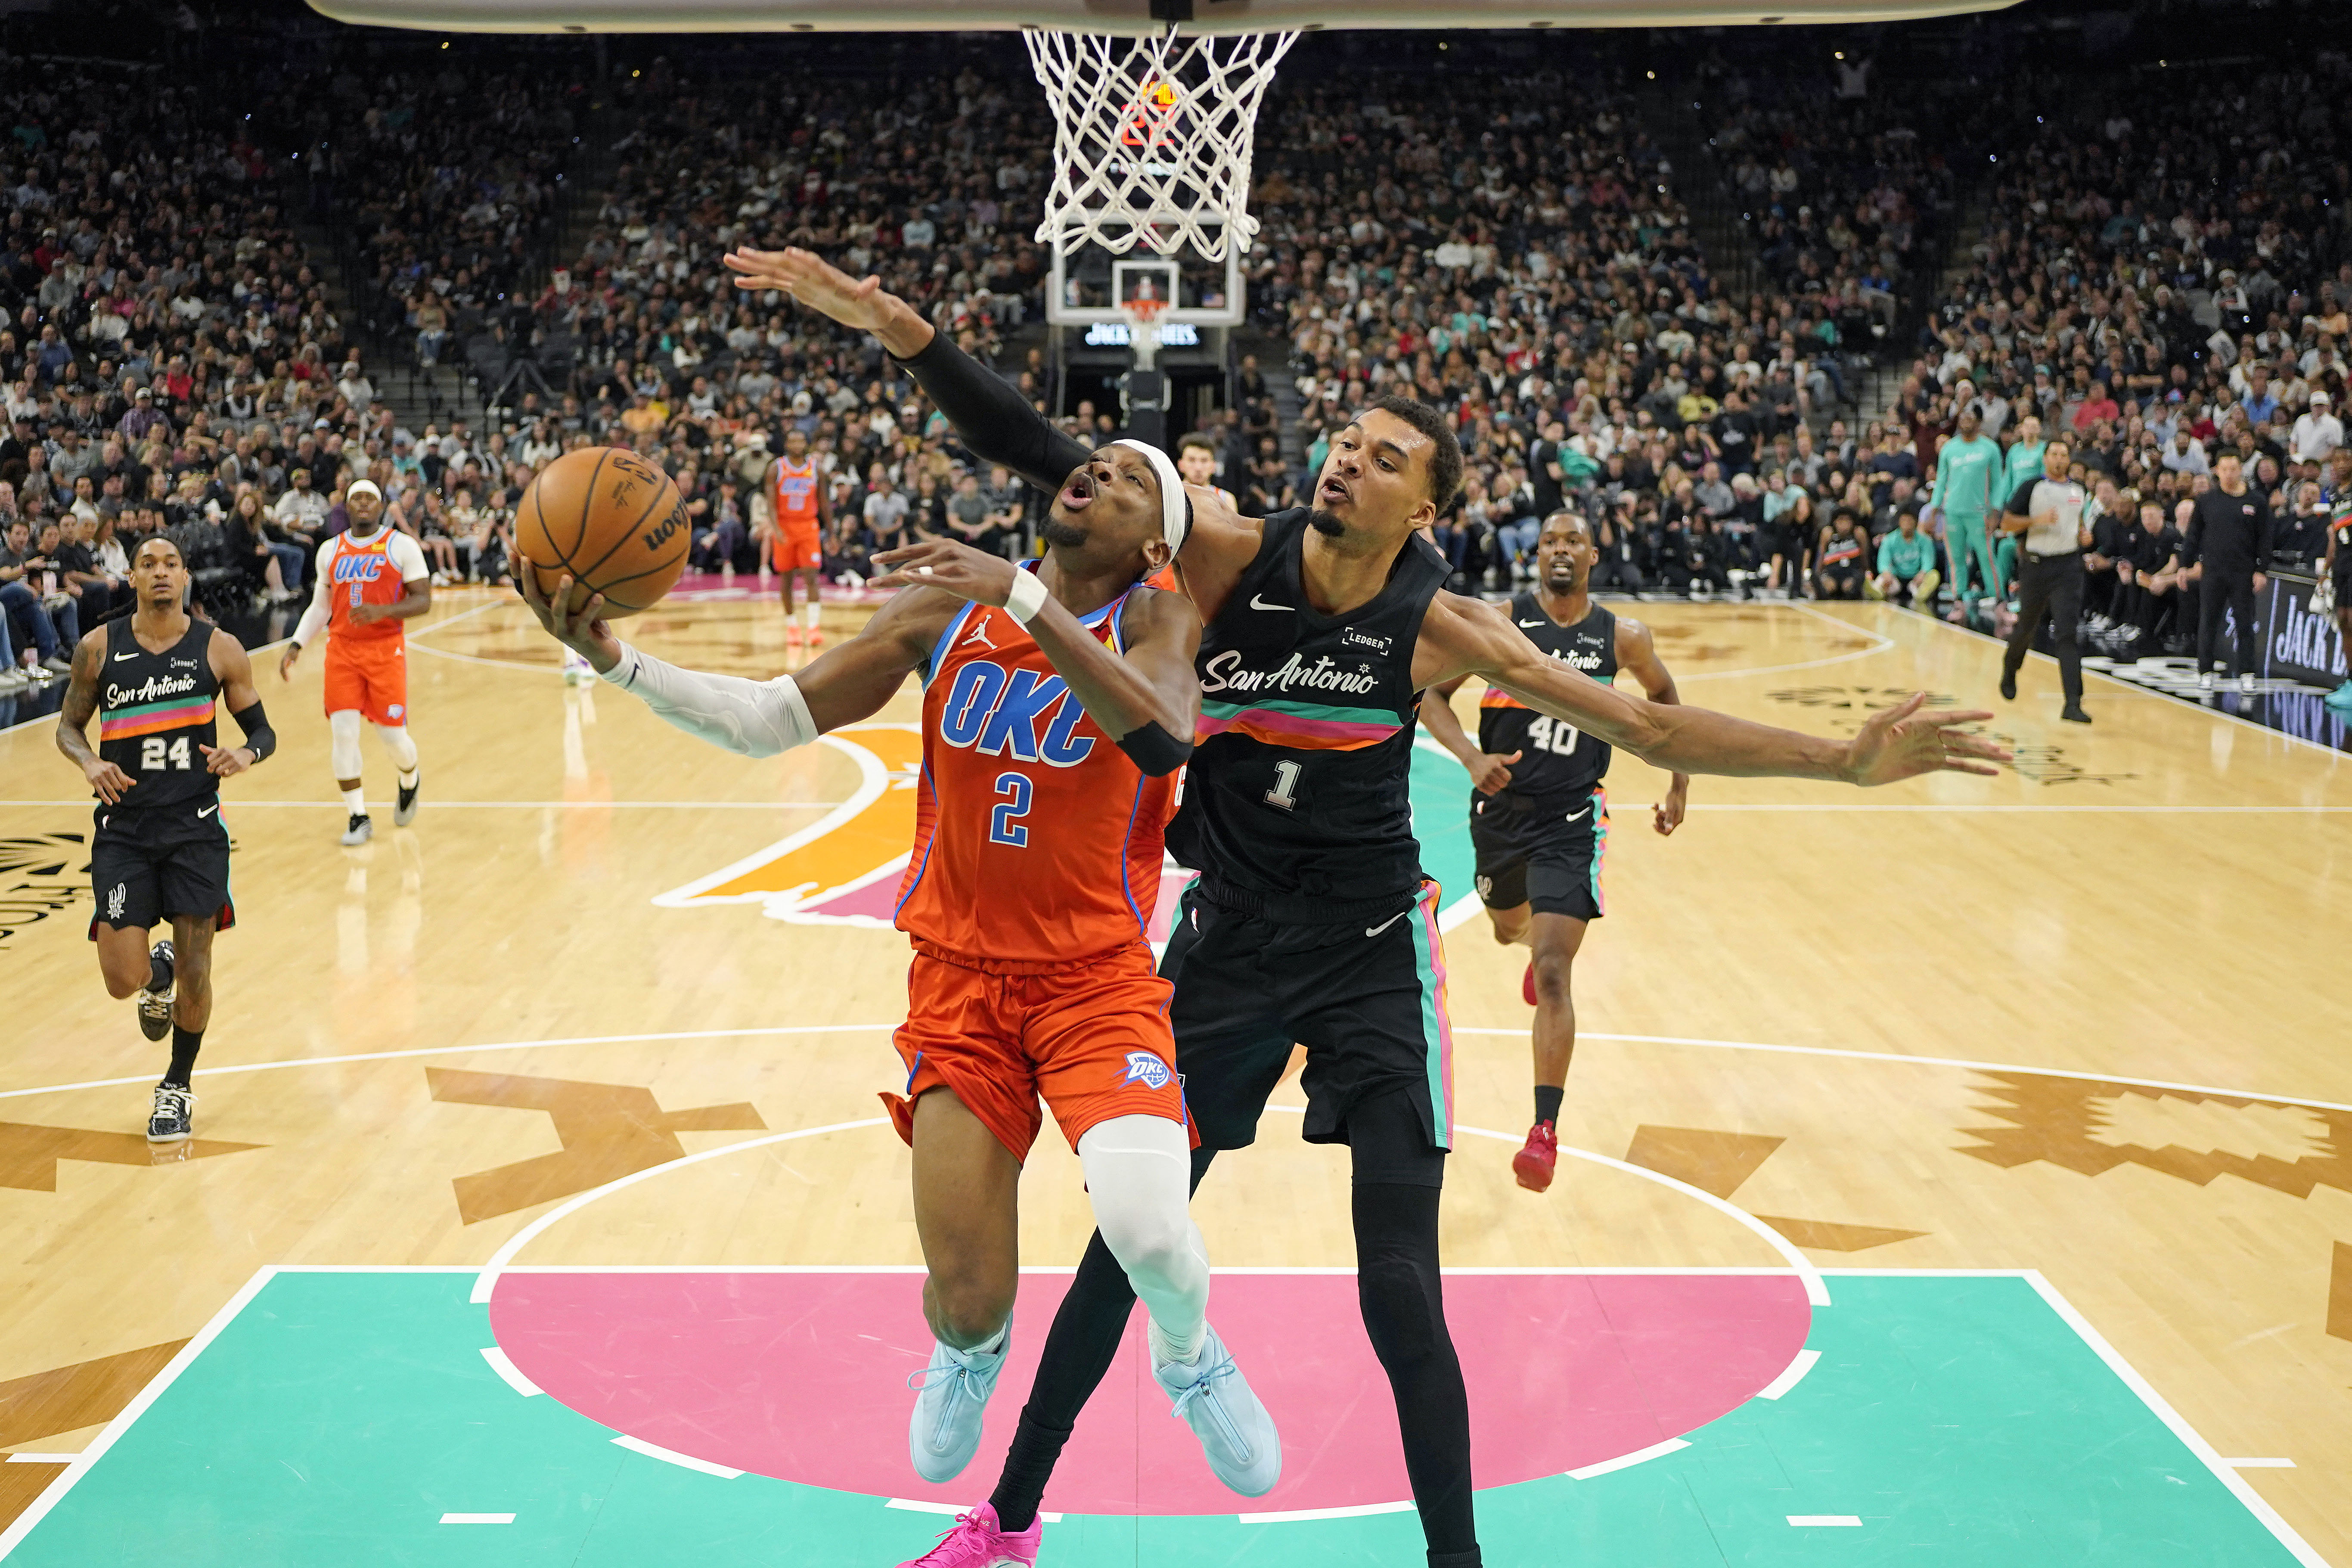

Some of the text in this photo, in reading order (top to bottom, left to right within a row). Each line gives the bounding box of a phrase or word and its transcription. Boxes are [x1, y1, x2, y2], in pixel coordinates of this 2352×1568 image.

[643, 495, 689, 551] lson
[334, 553, 387, 584] OKC
[350, 583, 363, 608] 5
[1349, 632, 1384, 649] LEDGER
[2276, 594, 2330, 672] JACK
[107, 673, 197, 709] San Antonio
[1200, 650, 1379, 694] San Antonio
[940, 660, 1097, 768] OKC
[1527, 714, 1579, 757] 40
[141, 736, 191, 771] 24
[1263, 760, 1302, 811] 1
[989, 771, 1033, 848] 2
[1127, 1061, 1164, 1079] OKC
